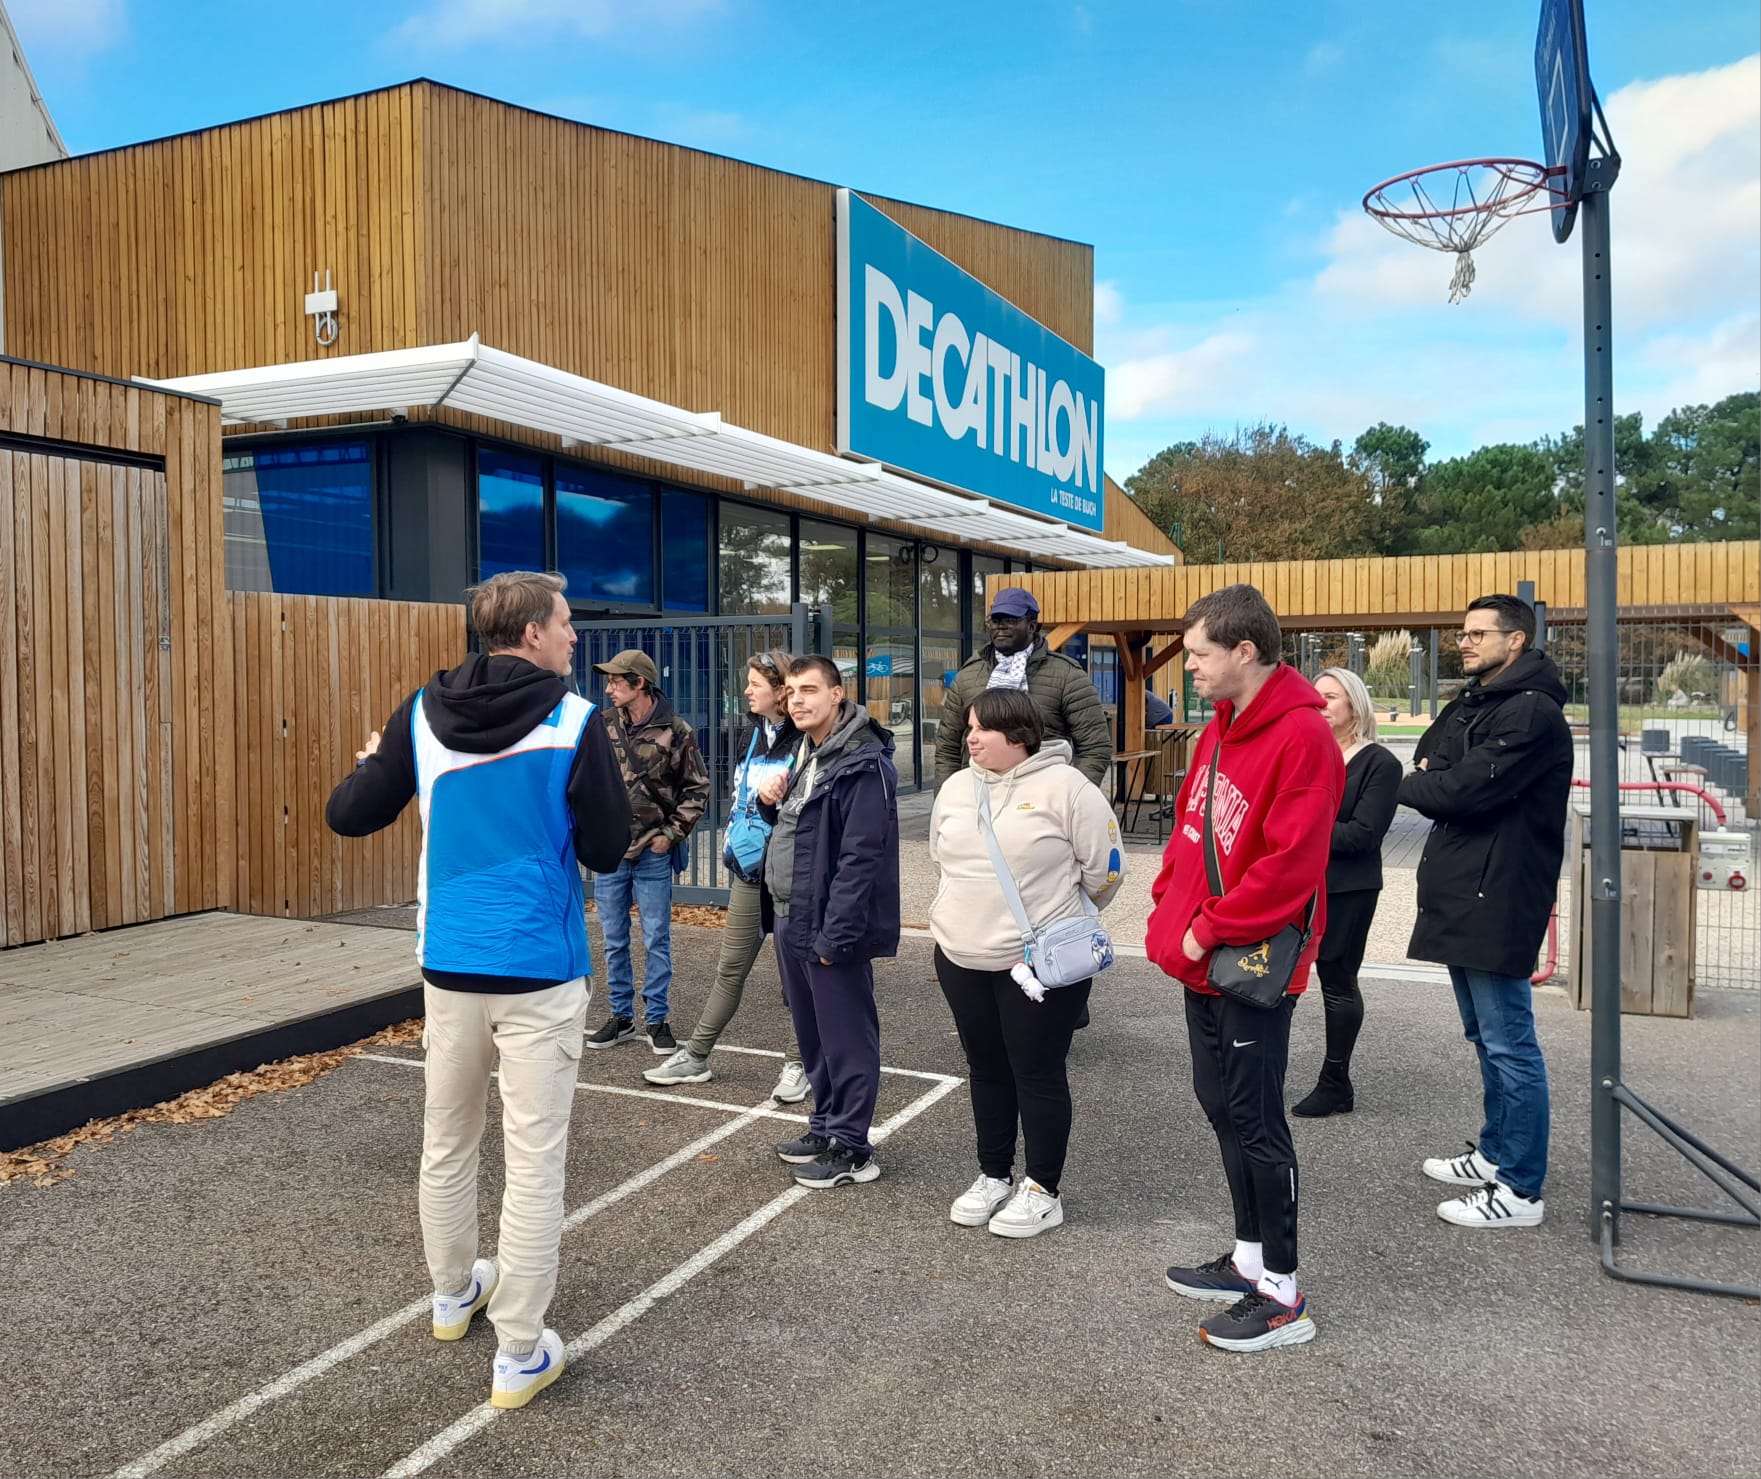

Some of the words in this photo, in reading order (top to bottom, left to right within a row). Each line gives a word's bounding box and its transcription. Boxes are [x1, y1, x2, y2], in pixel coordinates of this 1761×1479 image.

[865, 263, 1097, 493] DECATHLON
[1051, 488, 1058, 503] LA
[1059, 490, 1074, 509] TESTE
[1075, 496, 1082, 511] DE
[1083, 499, 1096, 516] BUCH
[1267, 1311, 1297, 1330] HOKA
